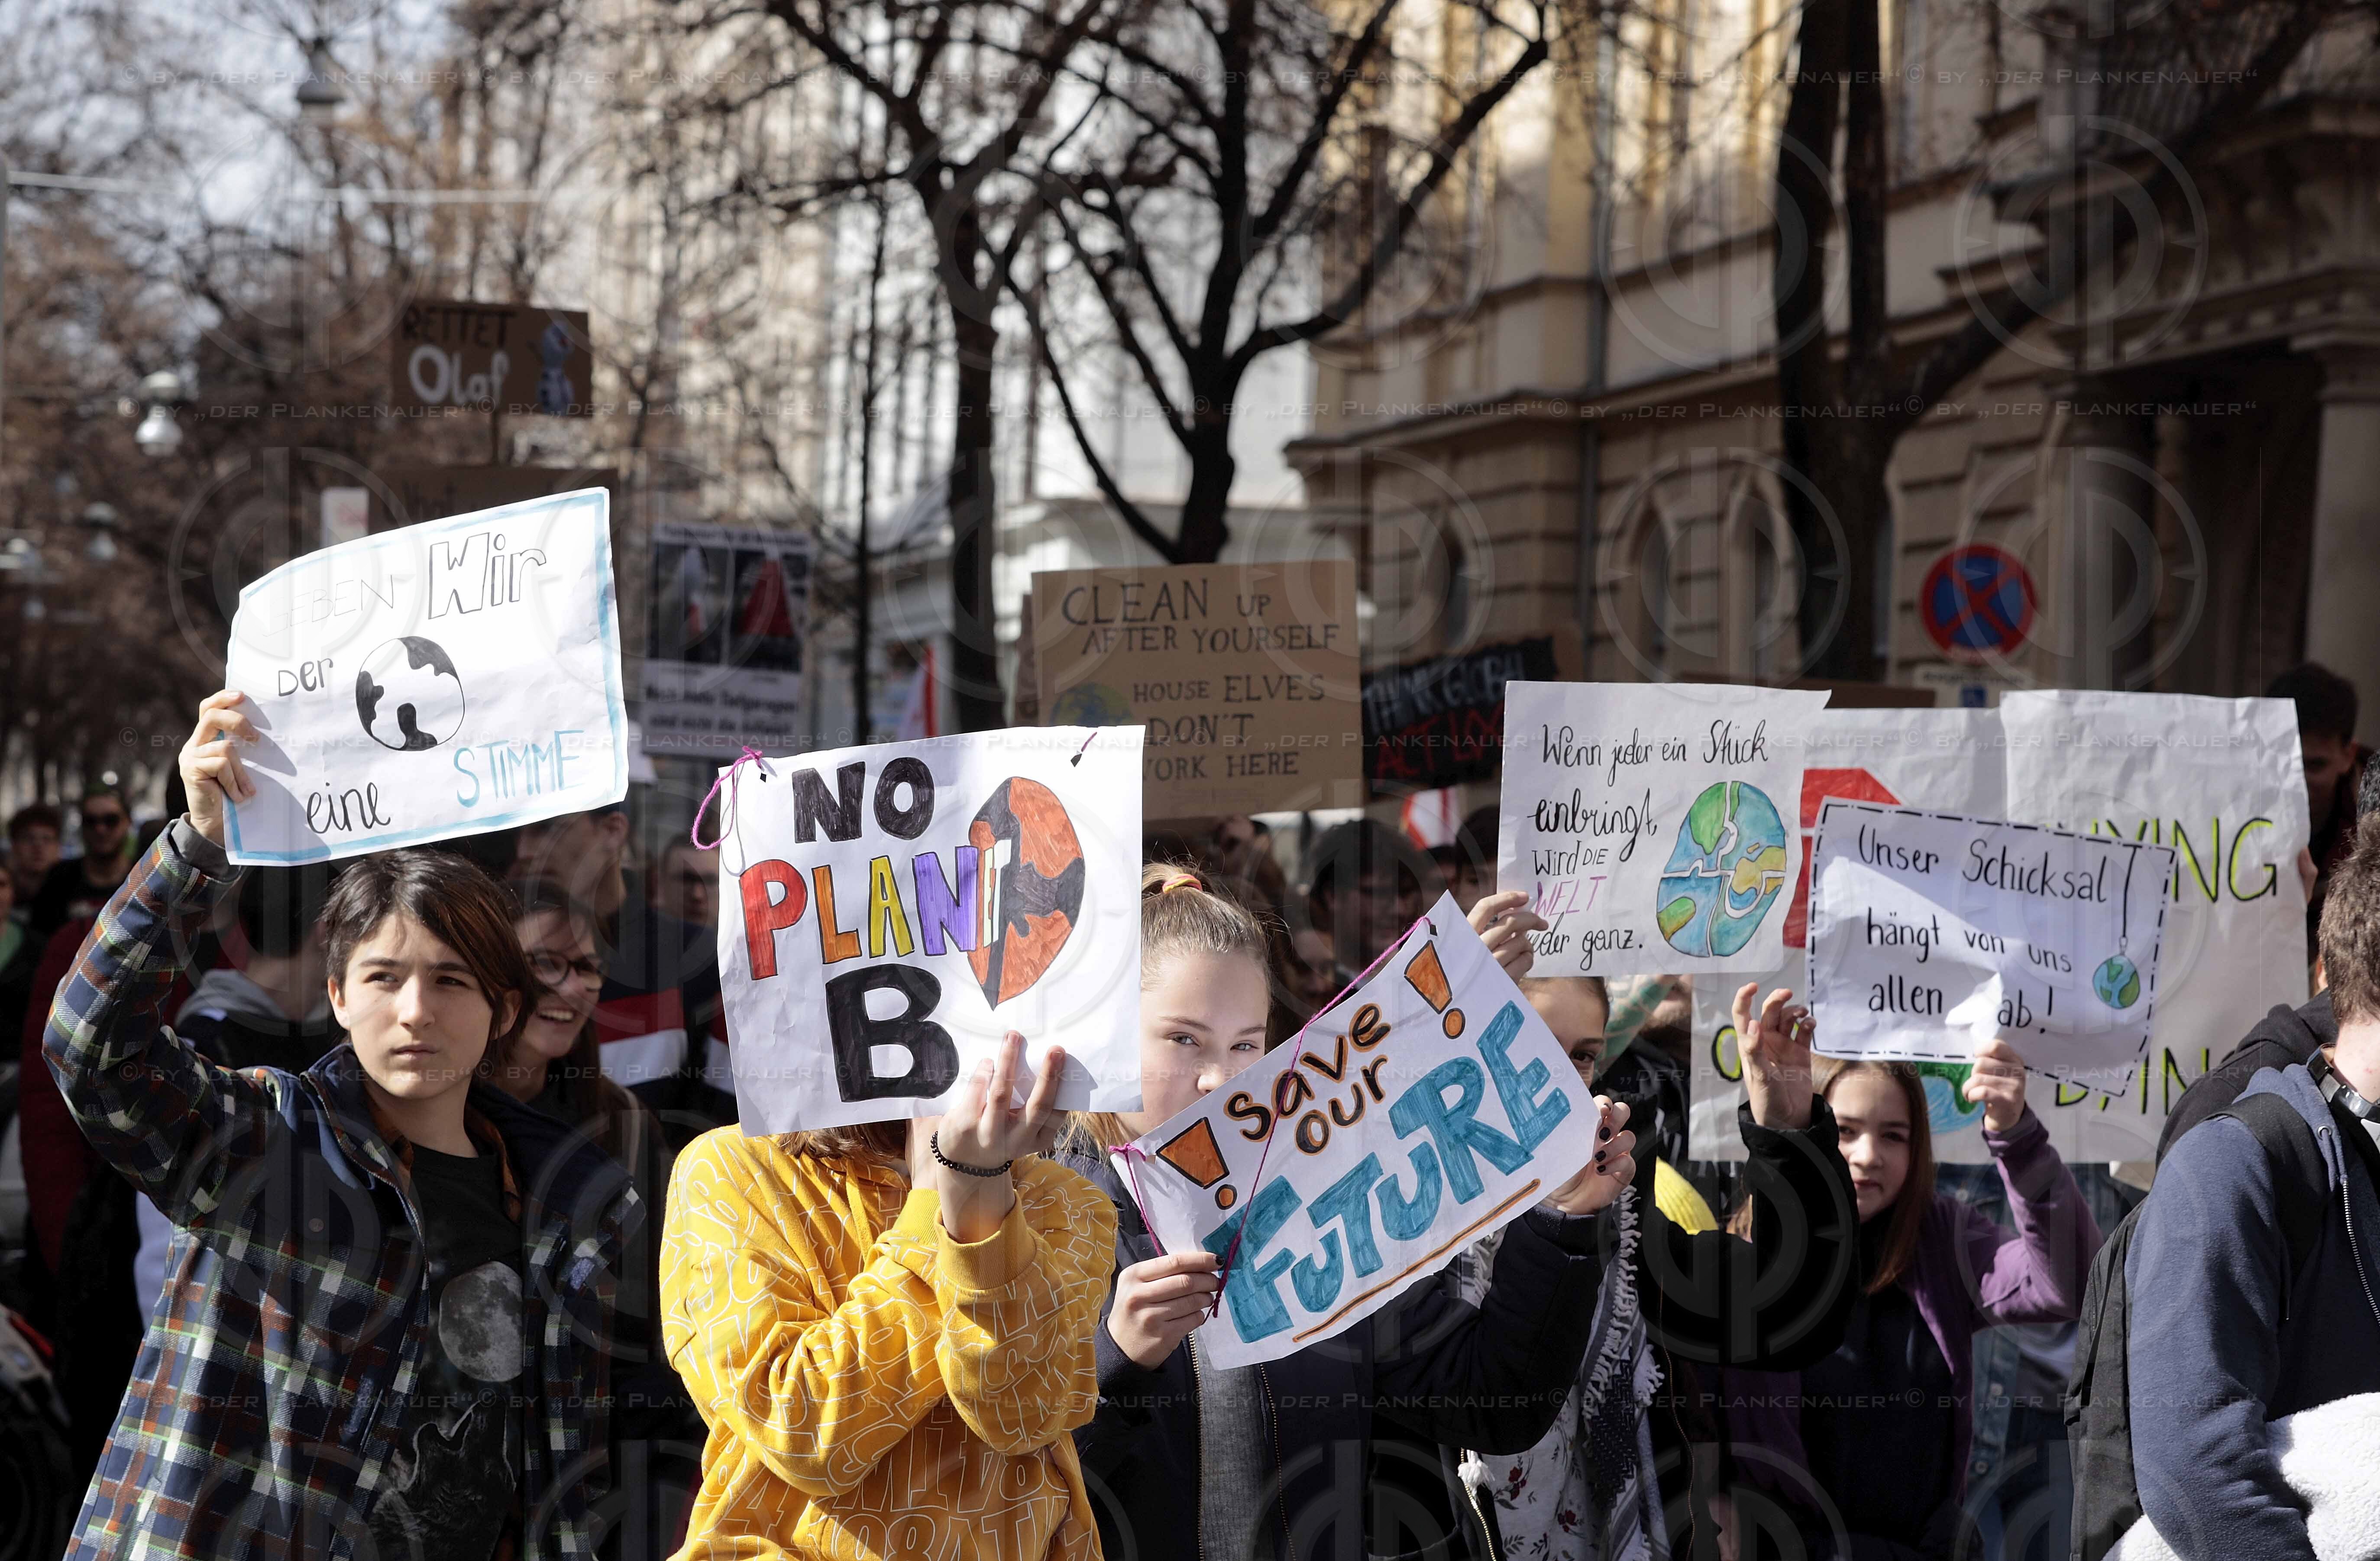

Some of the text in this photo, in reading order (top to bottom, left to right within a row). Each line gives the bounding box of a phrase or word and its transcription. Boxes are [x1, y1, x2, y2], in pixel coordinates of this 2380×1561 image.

[402, 305, 518, 348] RETTET
[408, 344, 511, 406] Olaf
[262, 532, 547, 637] GEBEN Wir
[1062, 578, 1271, 625] CLEAN UP
[1082, 624, 1339, 655] AFTER YOURSELF
[278, 658, 333, 696] Der
[1133, 674, 1326, 703] HOUSE ELVES
[1147, 713, 1255, 747] DON'T
[1542, 719, 1769, 787] Wenn jeder ein Stück
[306, 729, 585, 834] eine STIMME
[1226, 751, 1300, 779] HERE
[791, 756, 935, 844] NO
[1527, 787, 1658, 862] einbringt,
[1531, 840, 1609, 876] Wird DIE
[1858, 824, 1940, 874] Unser
[1962, 839, 2108, 903] Schicksal
[1535, 875, 1607, 917] WELT
[1580, 929, 1643, 971] ganz.
[1867, 906, 2073, 973] hängt von uns
[1868, 974, 1943, 1015] allen
[825, 963, 960, 1103] B
[1293, 1054, 1388, 1155] our
